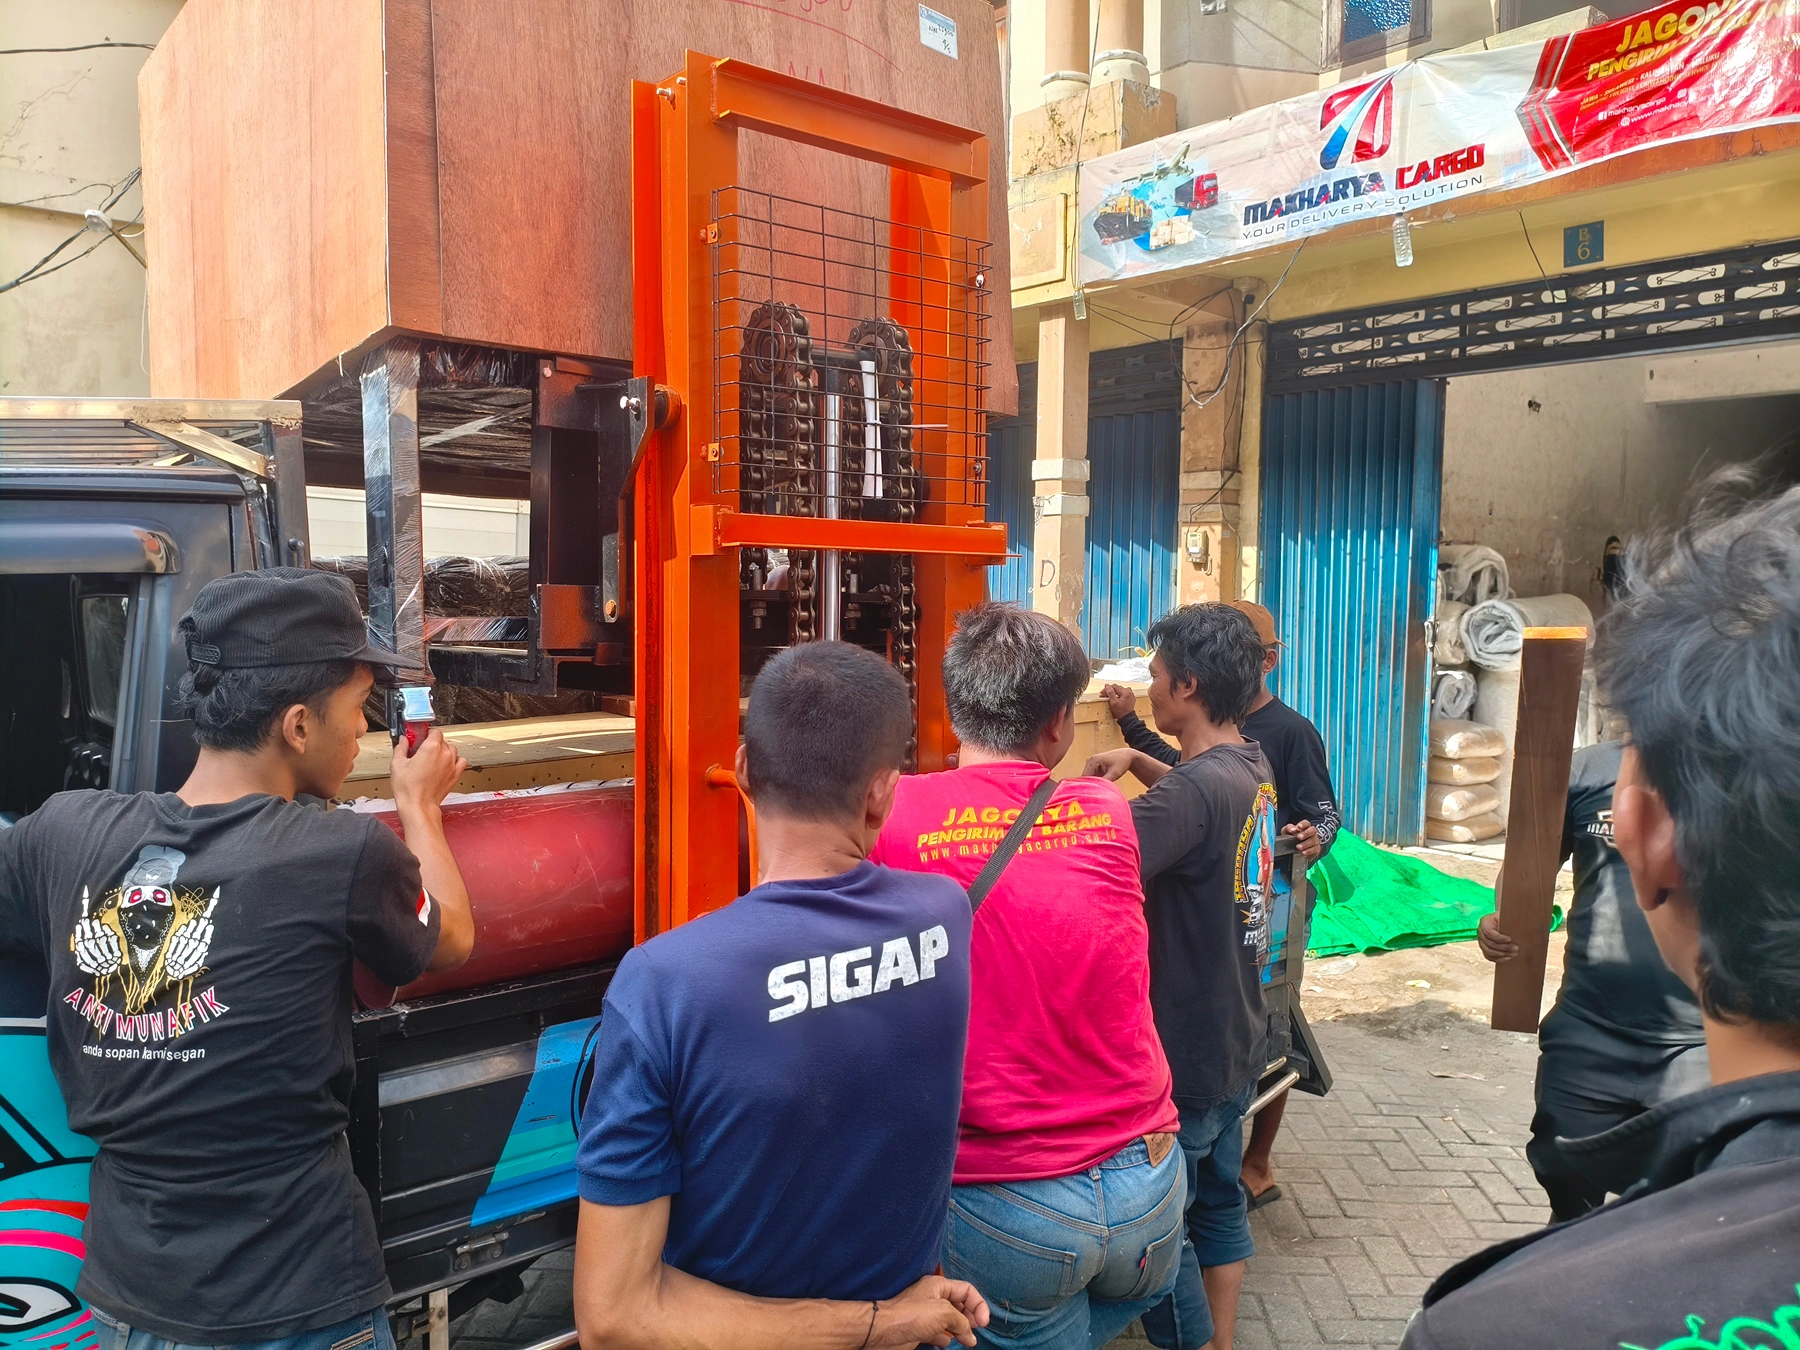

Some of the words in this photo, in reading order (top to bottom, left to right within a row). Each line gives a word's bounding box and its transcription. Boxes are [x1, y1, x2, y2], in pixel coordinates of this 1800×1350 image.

[1616, 0, 1738, 52] JAGON
[1243, 171, 1386, 226] MAKHARYA
[1395, 143, 1485, 190] CARGO
[1243, 223, 1285, 239] YOUR
[1291, 200, 1377, 228] DELIVERY
[1385, 175, 1483, 207] SOLUTION
[1577, 241, 1590, 260] 6
[1040, 560, 1055, 588] D
[917, 826, 1033, 849] PENGIRIM
[1042, 813, 1112, 836] BARANG
[919, 827, 1117, 863] www.makhyacargo.co.id
[767, 925, 949, 1023] SIGAP
[63, 987, 114, 1036] ANTI
[116, 985, 230, 1042] MUNAFIK
[83, 1044, 103, 1058] anda
[105, 1048, 139, 1061] sopan
